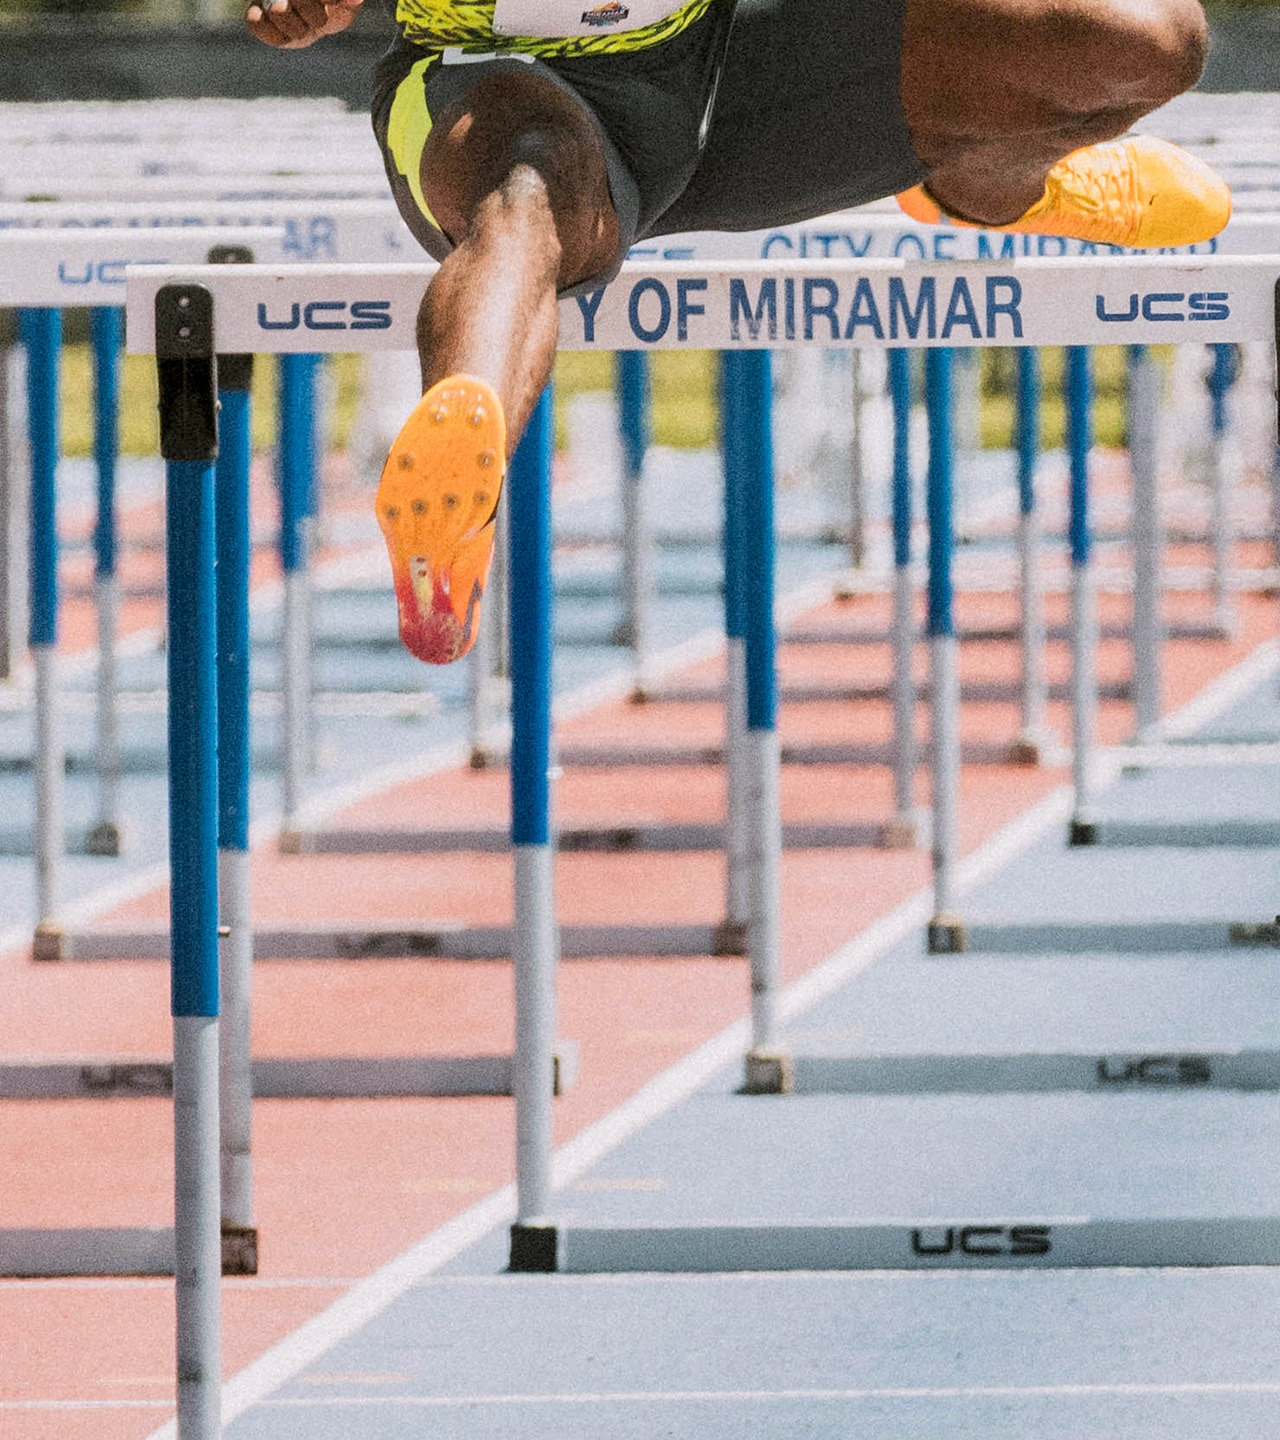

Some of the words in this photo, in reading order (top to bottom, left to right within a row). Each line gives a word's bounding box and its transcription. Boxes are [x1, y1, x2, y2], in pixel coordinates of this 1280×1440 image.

[58, 259, 168, 284] UC
[257, 301, 392, 331] UCS
[628, 277, 708, 343] OF
[729, 275, 1024, 342] MIRAMAR
[1096, 292, 1231, 322] UCS
[1099, 1055, 1212, 1085] UCS
[911, 1226, 1052, 1257] UCS
